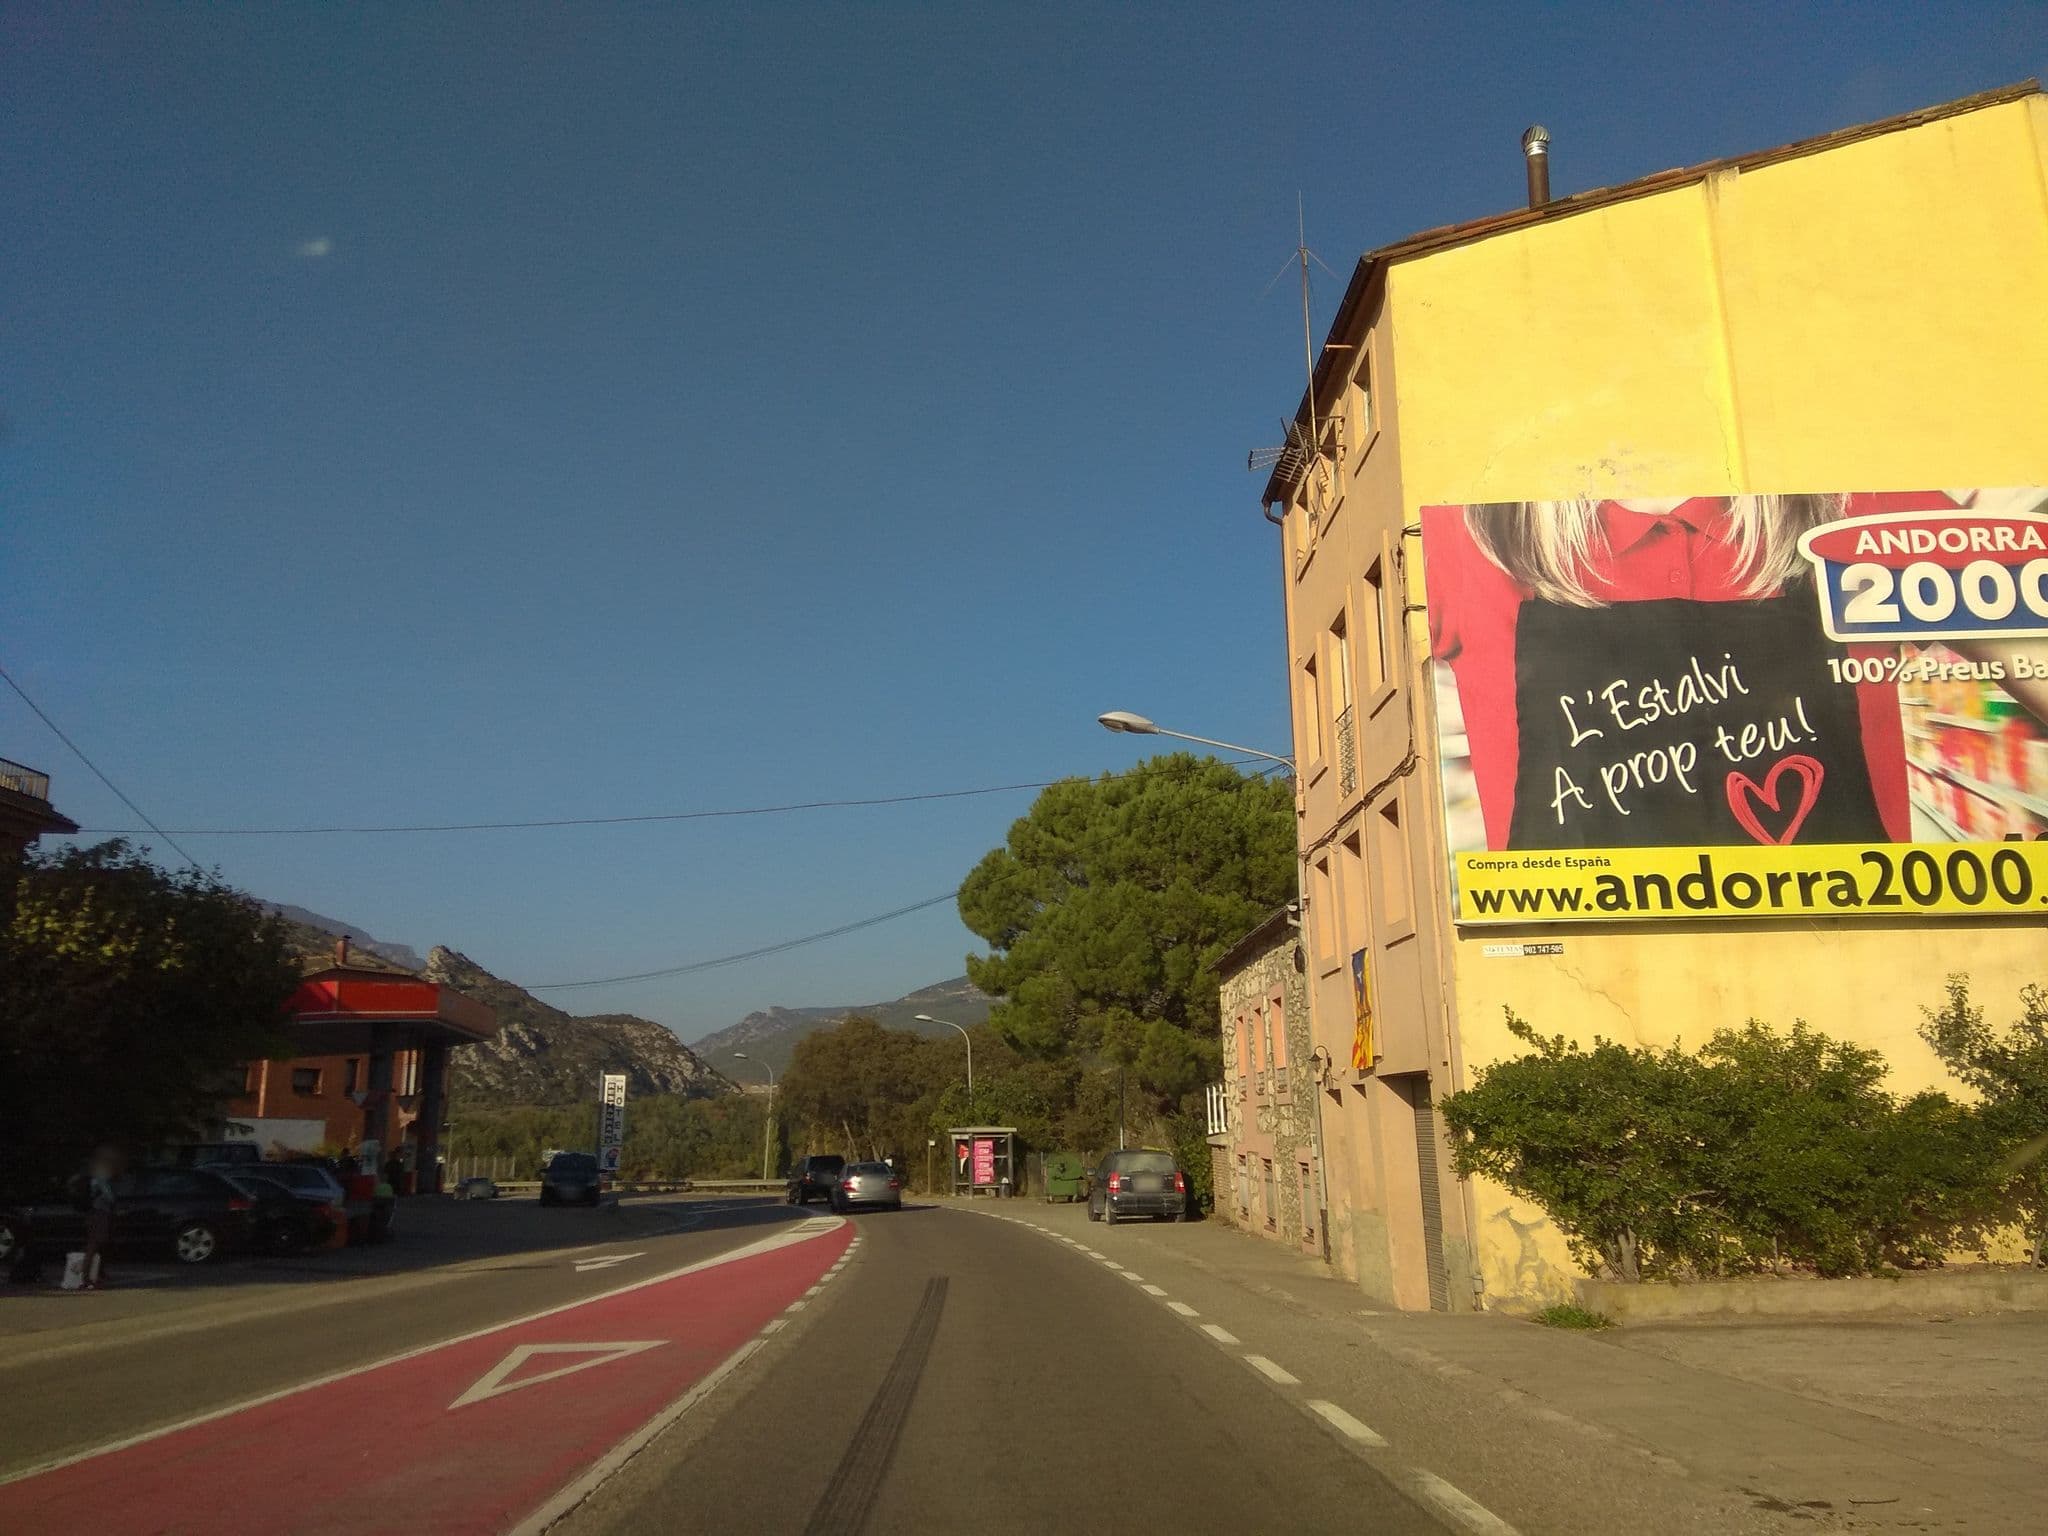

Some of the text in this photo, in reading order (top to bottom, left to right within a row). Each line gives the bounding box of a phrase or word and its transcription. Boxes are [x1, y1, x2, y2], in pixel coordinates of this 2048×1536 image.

[1855, 525, 2047, 555] ANDORRA
[1827, 656, 1912, 683] 100%
[1919, 657, 2006, 682] Preus
[1559, 653, 1749, 748] L'Estalvi
[1551, 696, 1818, 825] A prop teu!
[1467, 856, 1611, 872] Compra desde España
[614, 1084, 624, 1142] HOTEL
